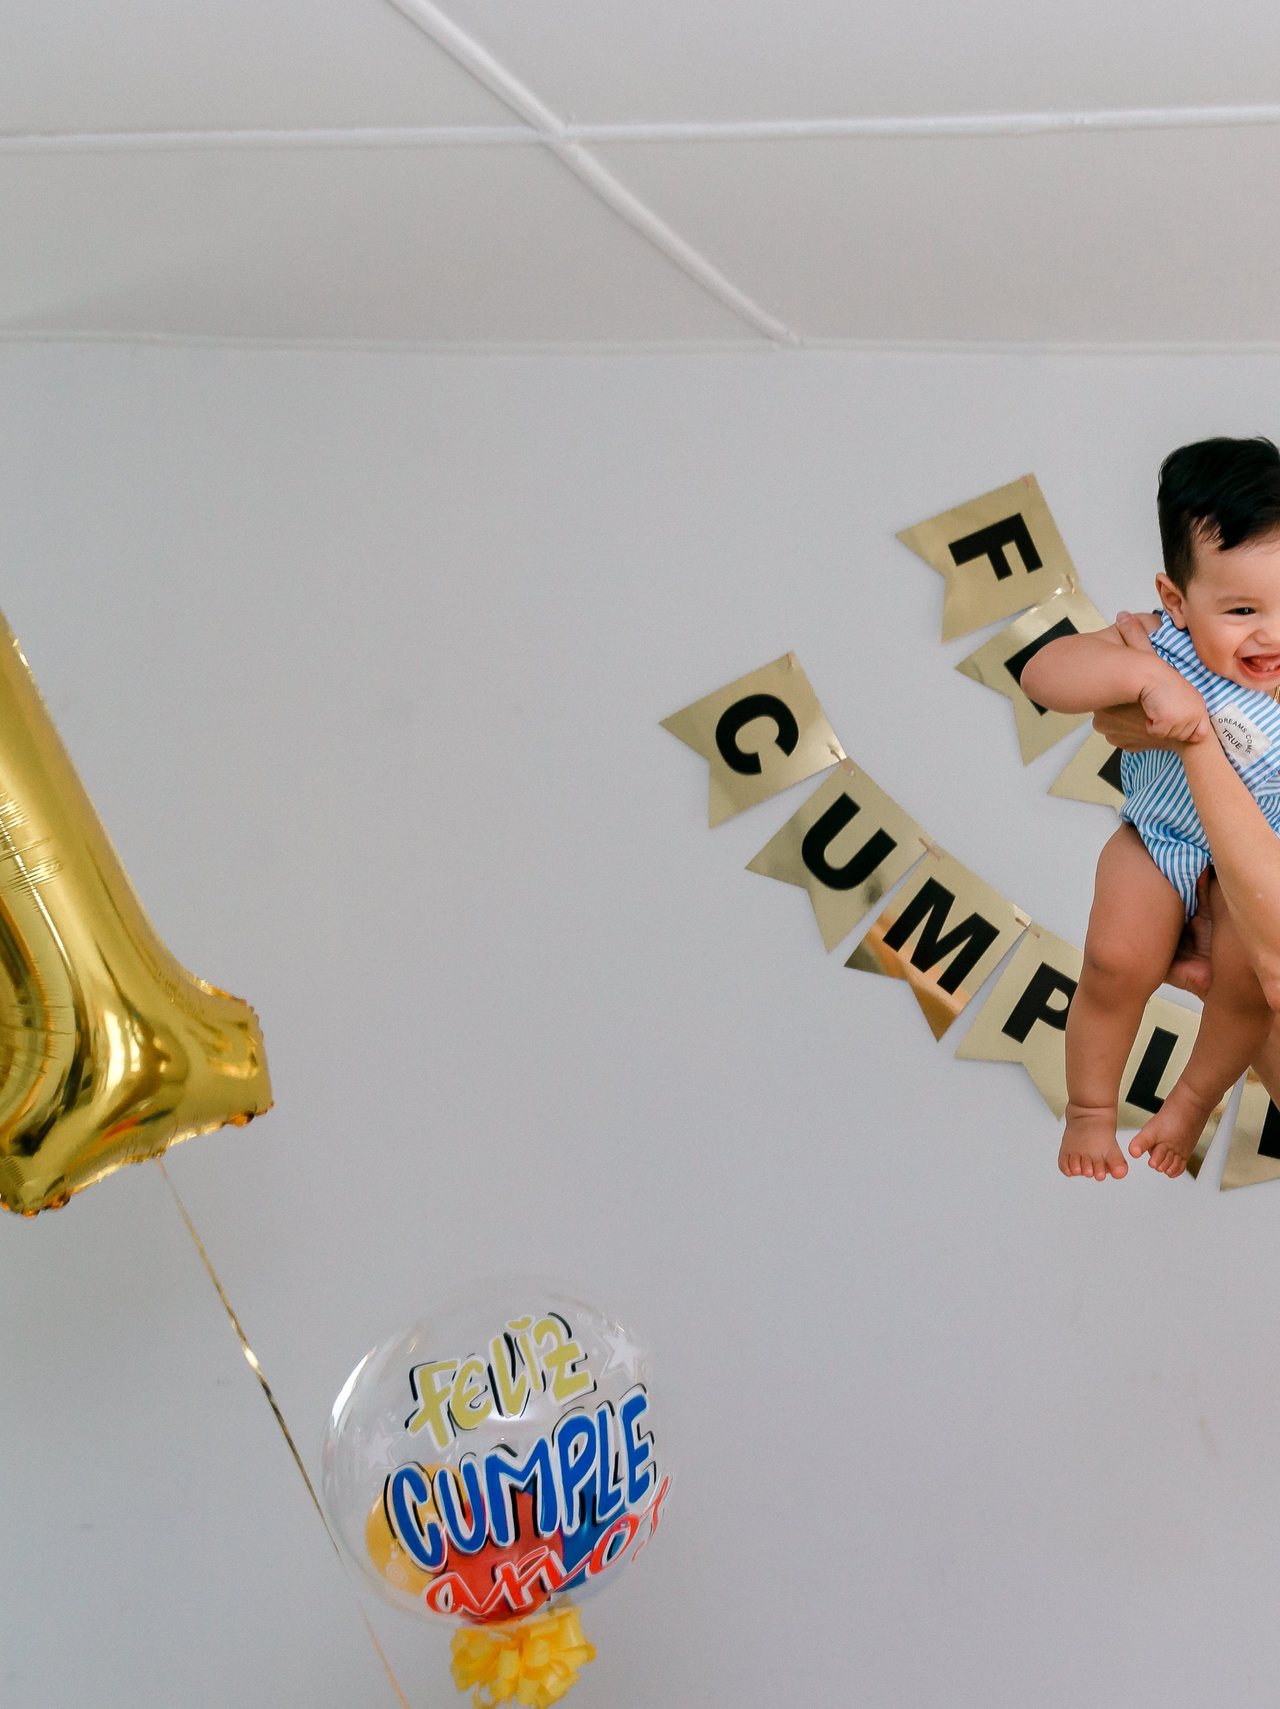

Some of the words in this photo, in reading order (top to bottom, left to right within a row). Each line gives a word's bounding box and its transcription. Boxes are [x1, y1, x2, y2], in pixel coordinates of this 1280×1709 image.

[1217, 717, 1248, 733] DREAMS
[1245, 734, 1253, 754] COME
[1221, 728, 1243, 750] TRUE
[406, 1313, 596, 1449] FELIZ
[387, 1386, 655, 1571] CUMPLE
